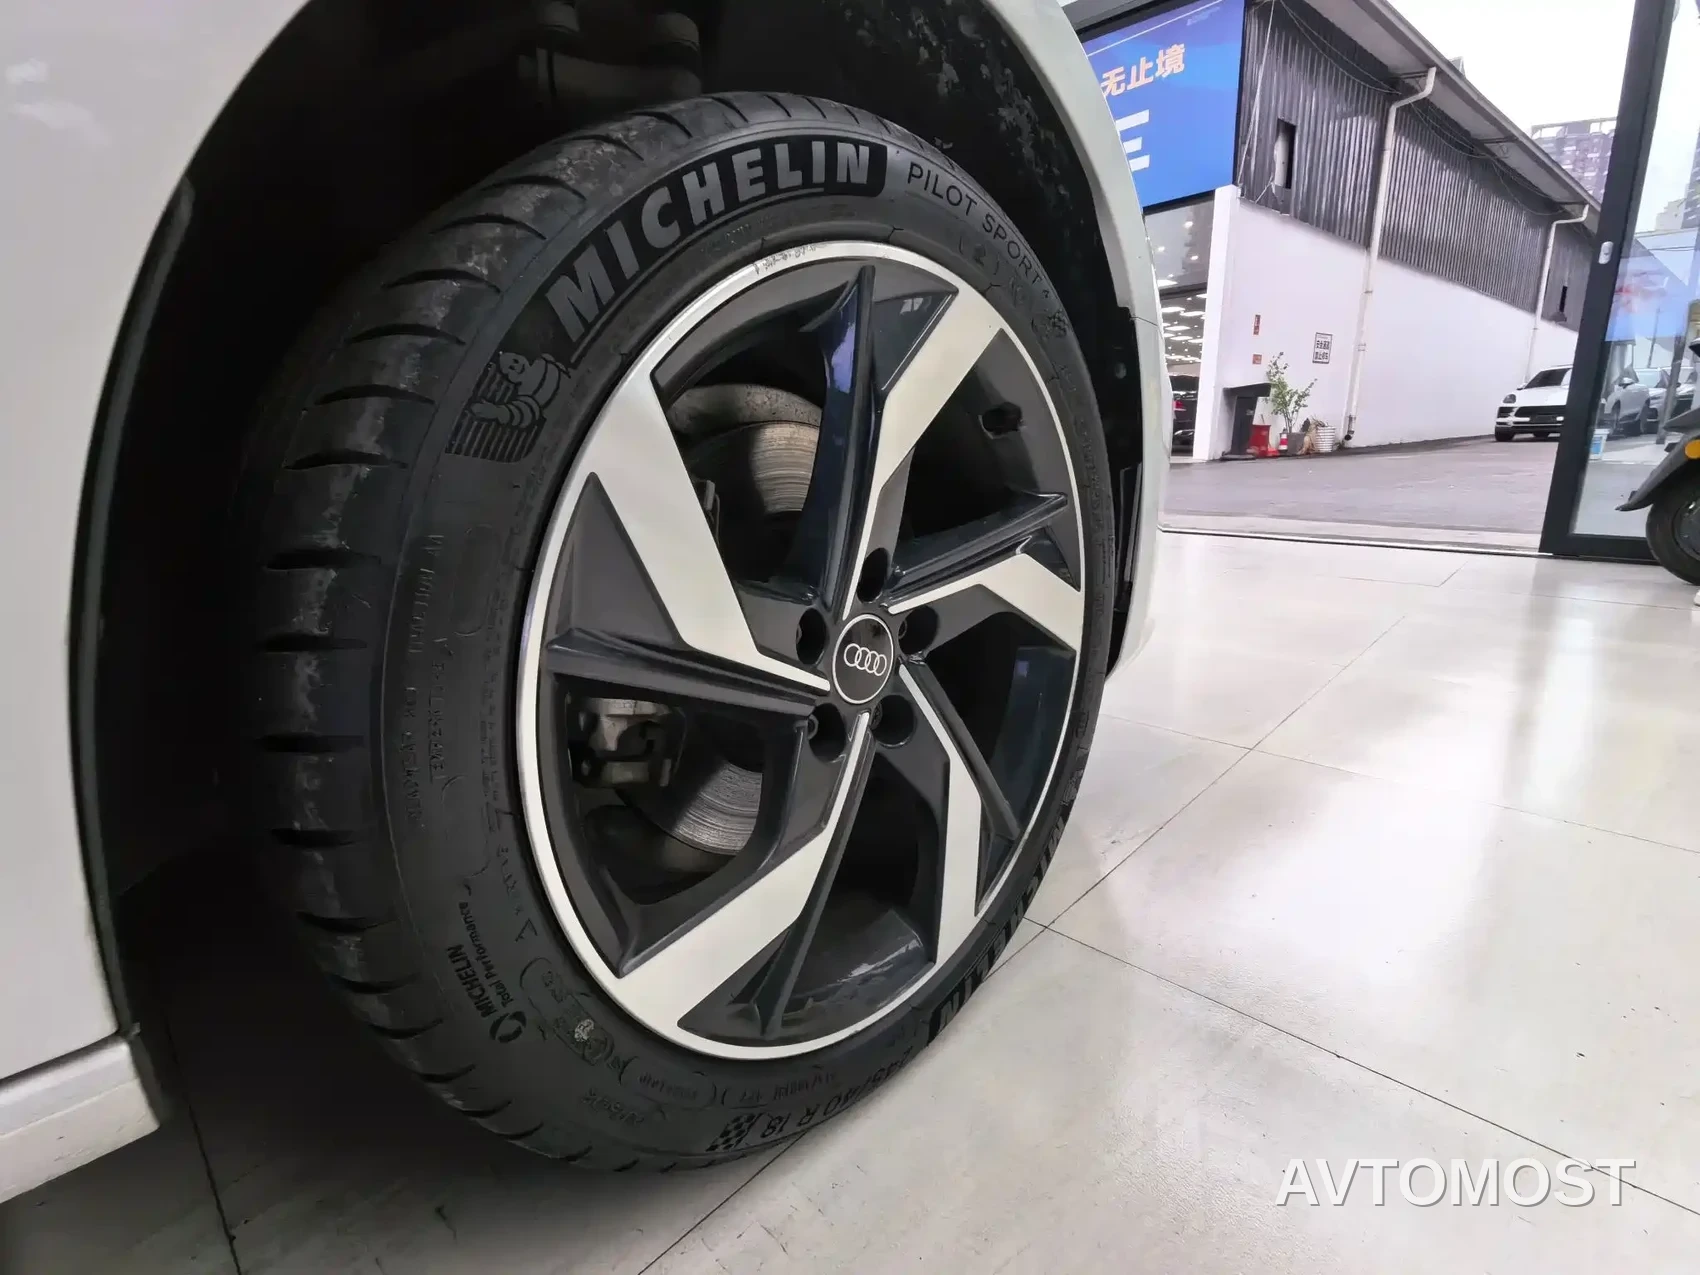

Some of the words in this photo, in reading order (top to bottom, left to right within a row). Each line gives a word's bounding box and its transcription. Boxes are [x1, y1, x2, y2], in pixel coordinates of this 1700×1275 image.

[1101, 43, 1185, 97] 无止境
[545, 140, 870, 342] MICHELIN
[907, 161, 978, 217] PILOT
[982, 213, 1043, 285] SPORT
[458, 901, 497, 980] Performance
[447, 944, 498, 1018] MICHELIN
[489, 979, 516, 1008] Total
[760, 1112, 792, 1139] 18
[796, 1103, 821, 1128] R
